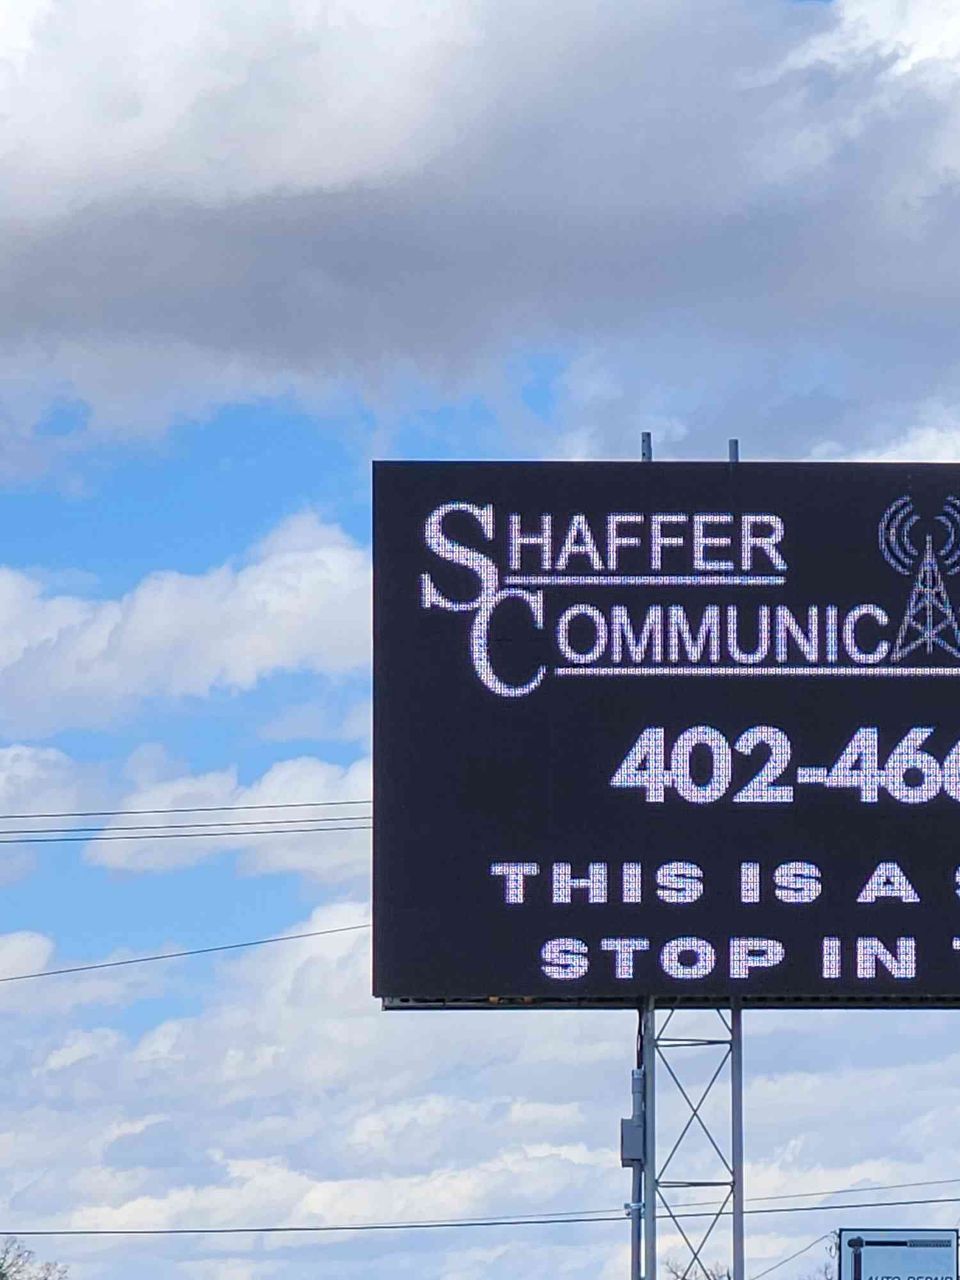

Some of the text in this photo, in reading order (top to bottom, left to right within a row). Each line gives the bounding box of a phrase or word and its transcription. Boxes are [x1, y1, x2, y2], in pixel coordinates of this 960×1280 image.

[421, 502, 788, 612] SHAFFER
[491, 861, 704, 904] THIS
[740, 861, 822, 903] IS
[856, 862, 921, 903] A
[541, 936, 785, 980] STOP
[822, 936, 917, 979] IN
